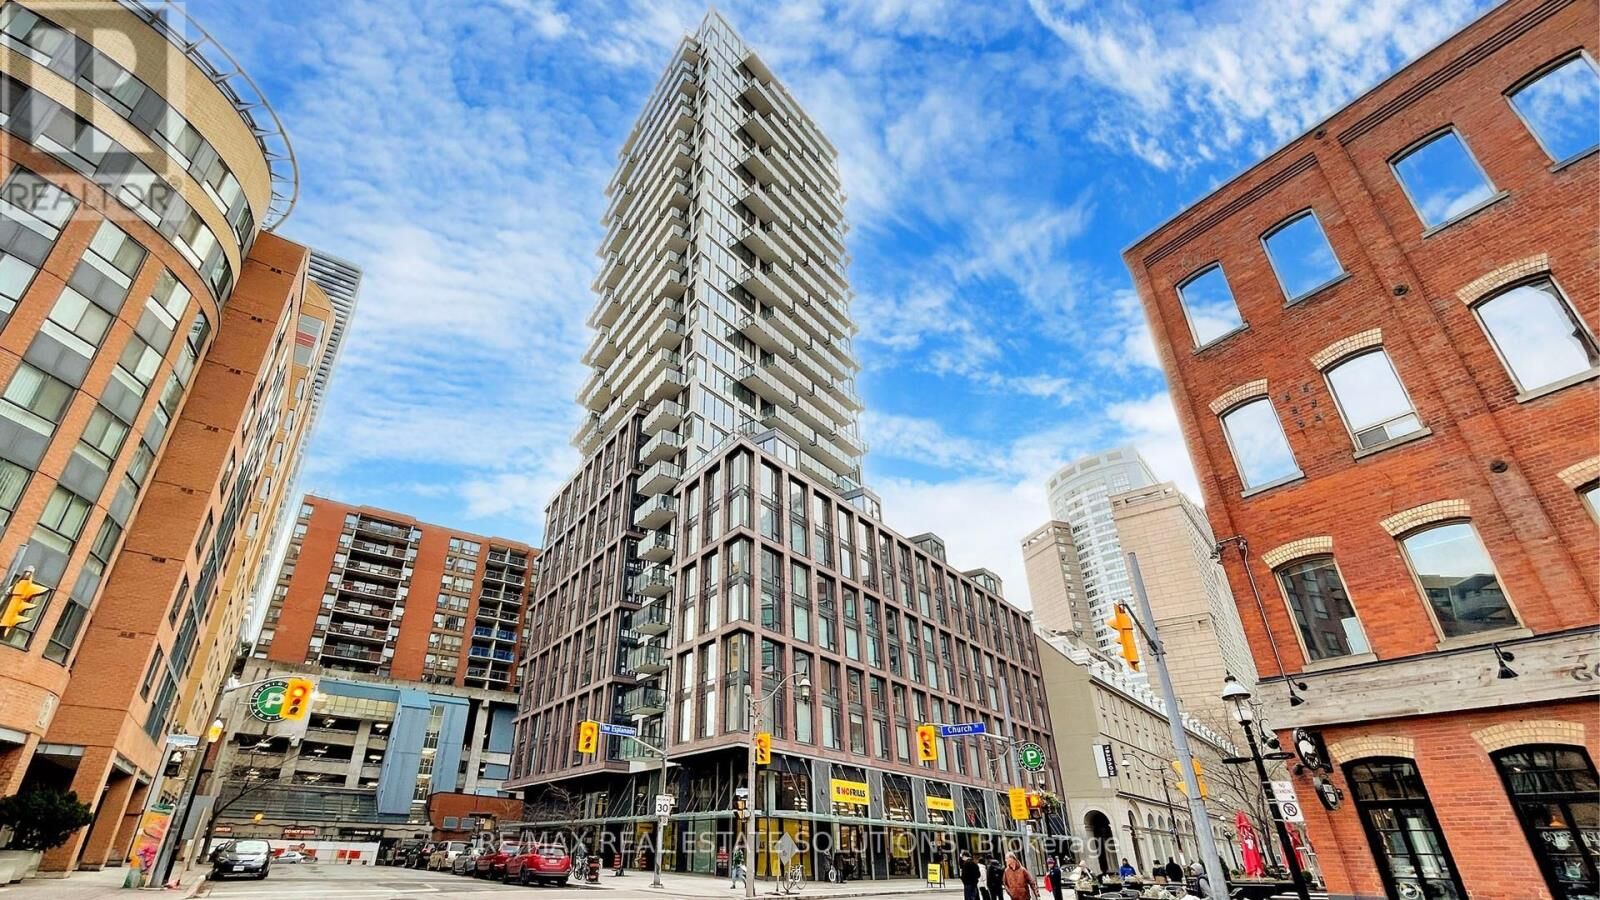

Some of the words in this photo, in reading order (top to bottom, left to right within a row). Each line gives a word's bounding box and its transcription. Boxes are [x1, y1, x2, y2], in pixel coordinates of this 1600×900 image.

[611, 724, 635, 736] Esplanade
[947, 724, 973, 734] Church
[1026, 750, 1037, 762] P
[1104, 745, 1115, 776] NOVOTEL
[656, 803, 668, 813] 30
